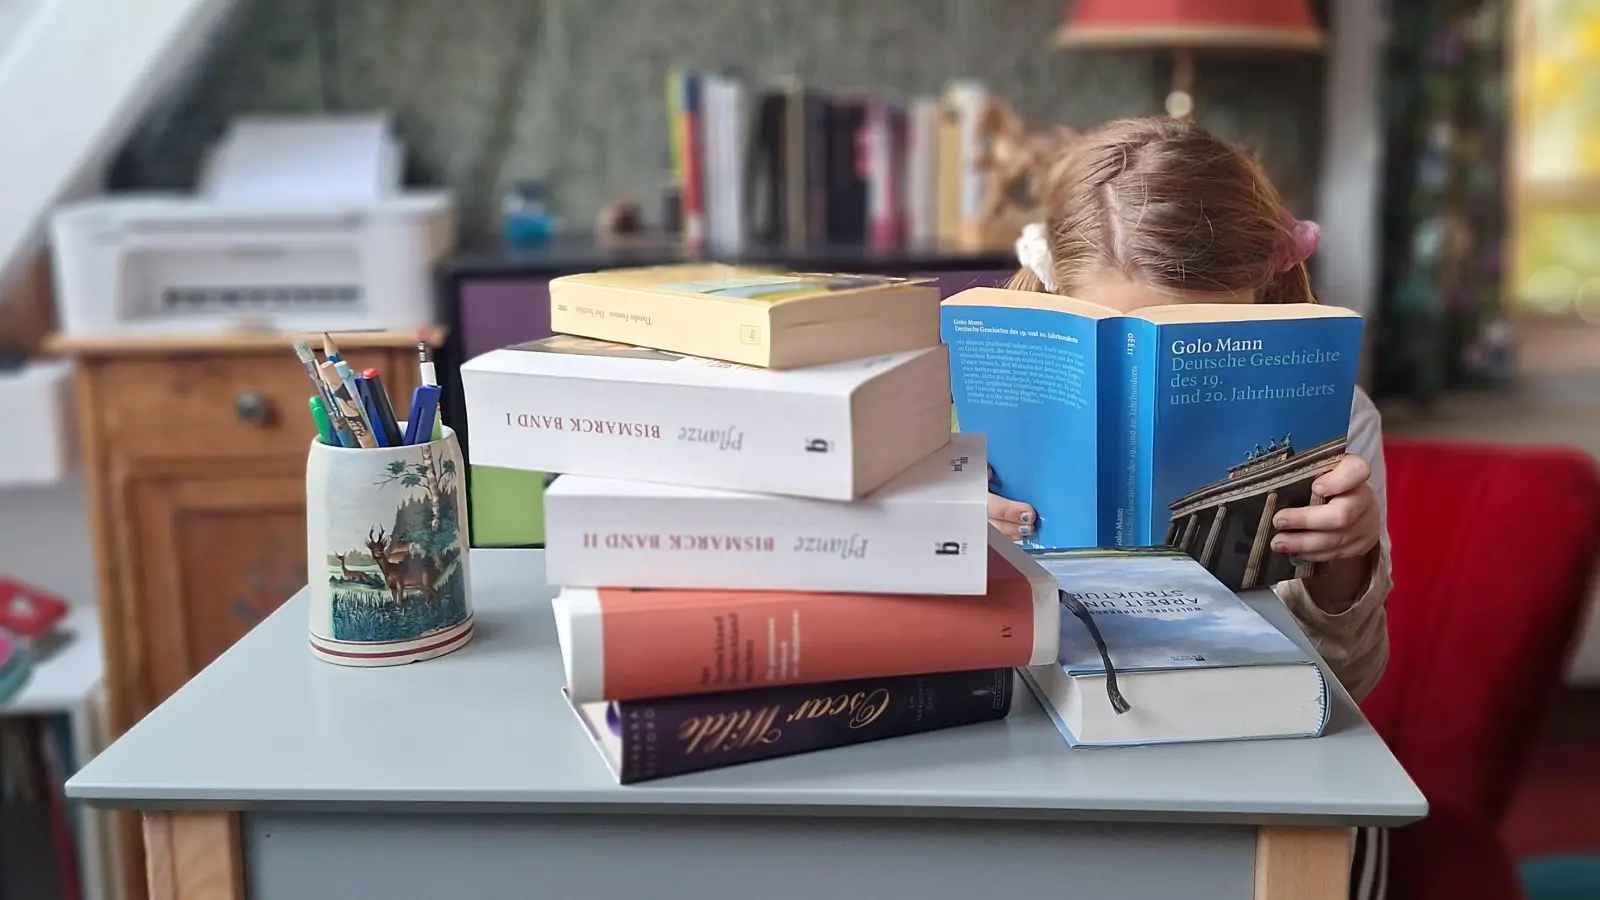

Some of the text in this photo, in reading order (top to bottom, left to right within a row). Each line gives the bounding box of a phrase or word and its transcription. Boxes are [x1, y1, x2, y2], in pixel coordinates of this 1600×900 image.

[1127, 332, 1136, 355] 11330
[1171, 338, 1263, 355] Golo Mann
[1171, 348, 1341, 371] Deutsche Geschichte
[1170, 374, 1224, 389] des 19.
[1170, 383, 1335, 405] und 20. Jahrhunderts
[505, 412, 744, 451] Pflanze BISMARCK BAND I
[1115, 508, 1124, 530] Mann
[583, 533, 869, 559] Pflanze BISMARCK BAND II
[1073, 589, 1184, 600] STRUKTUR
[1084, 598, 1200, 609] ARBEIT UN
[678, 688, 891, 756] Oscar Wilde
